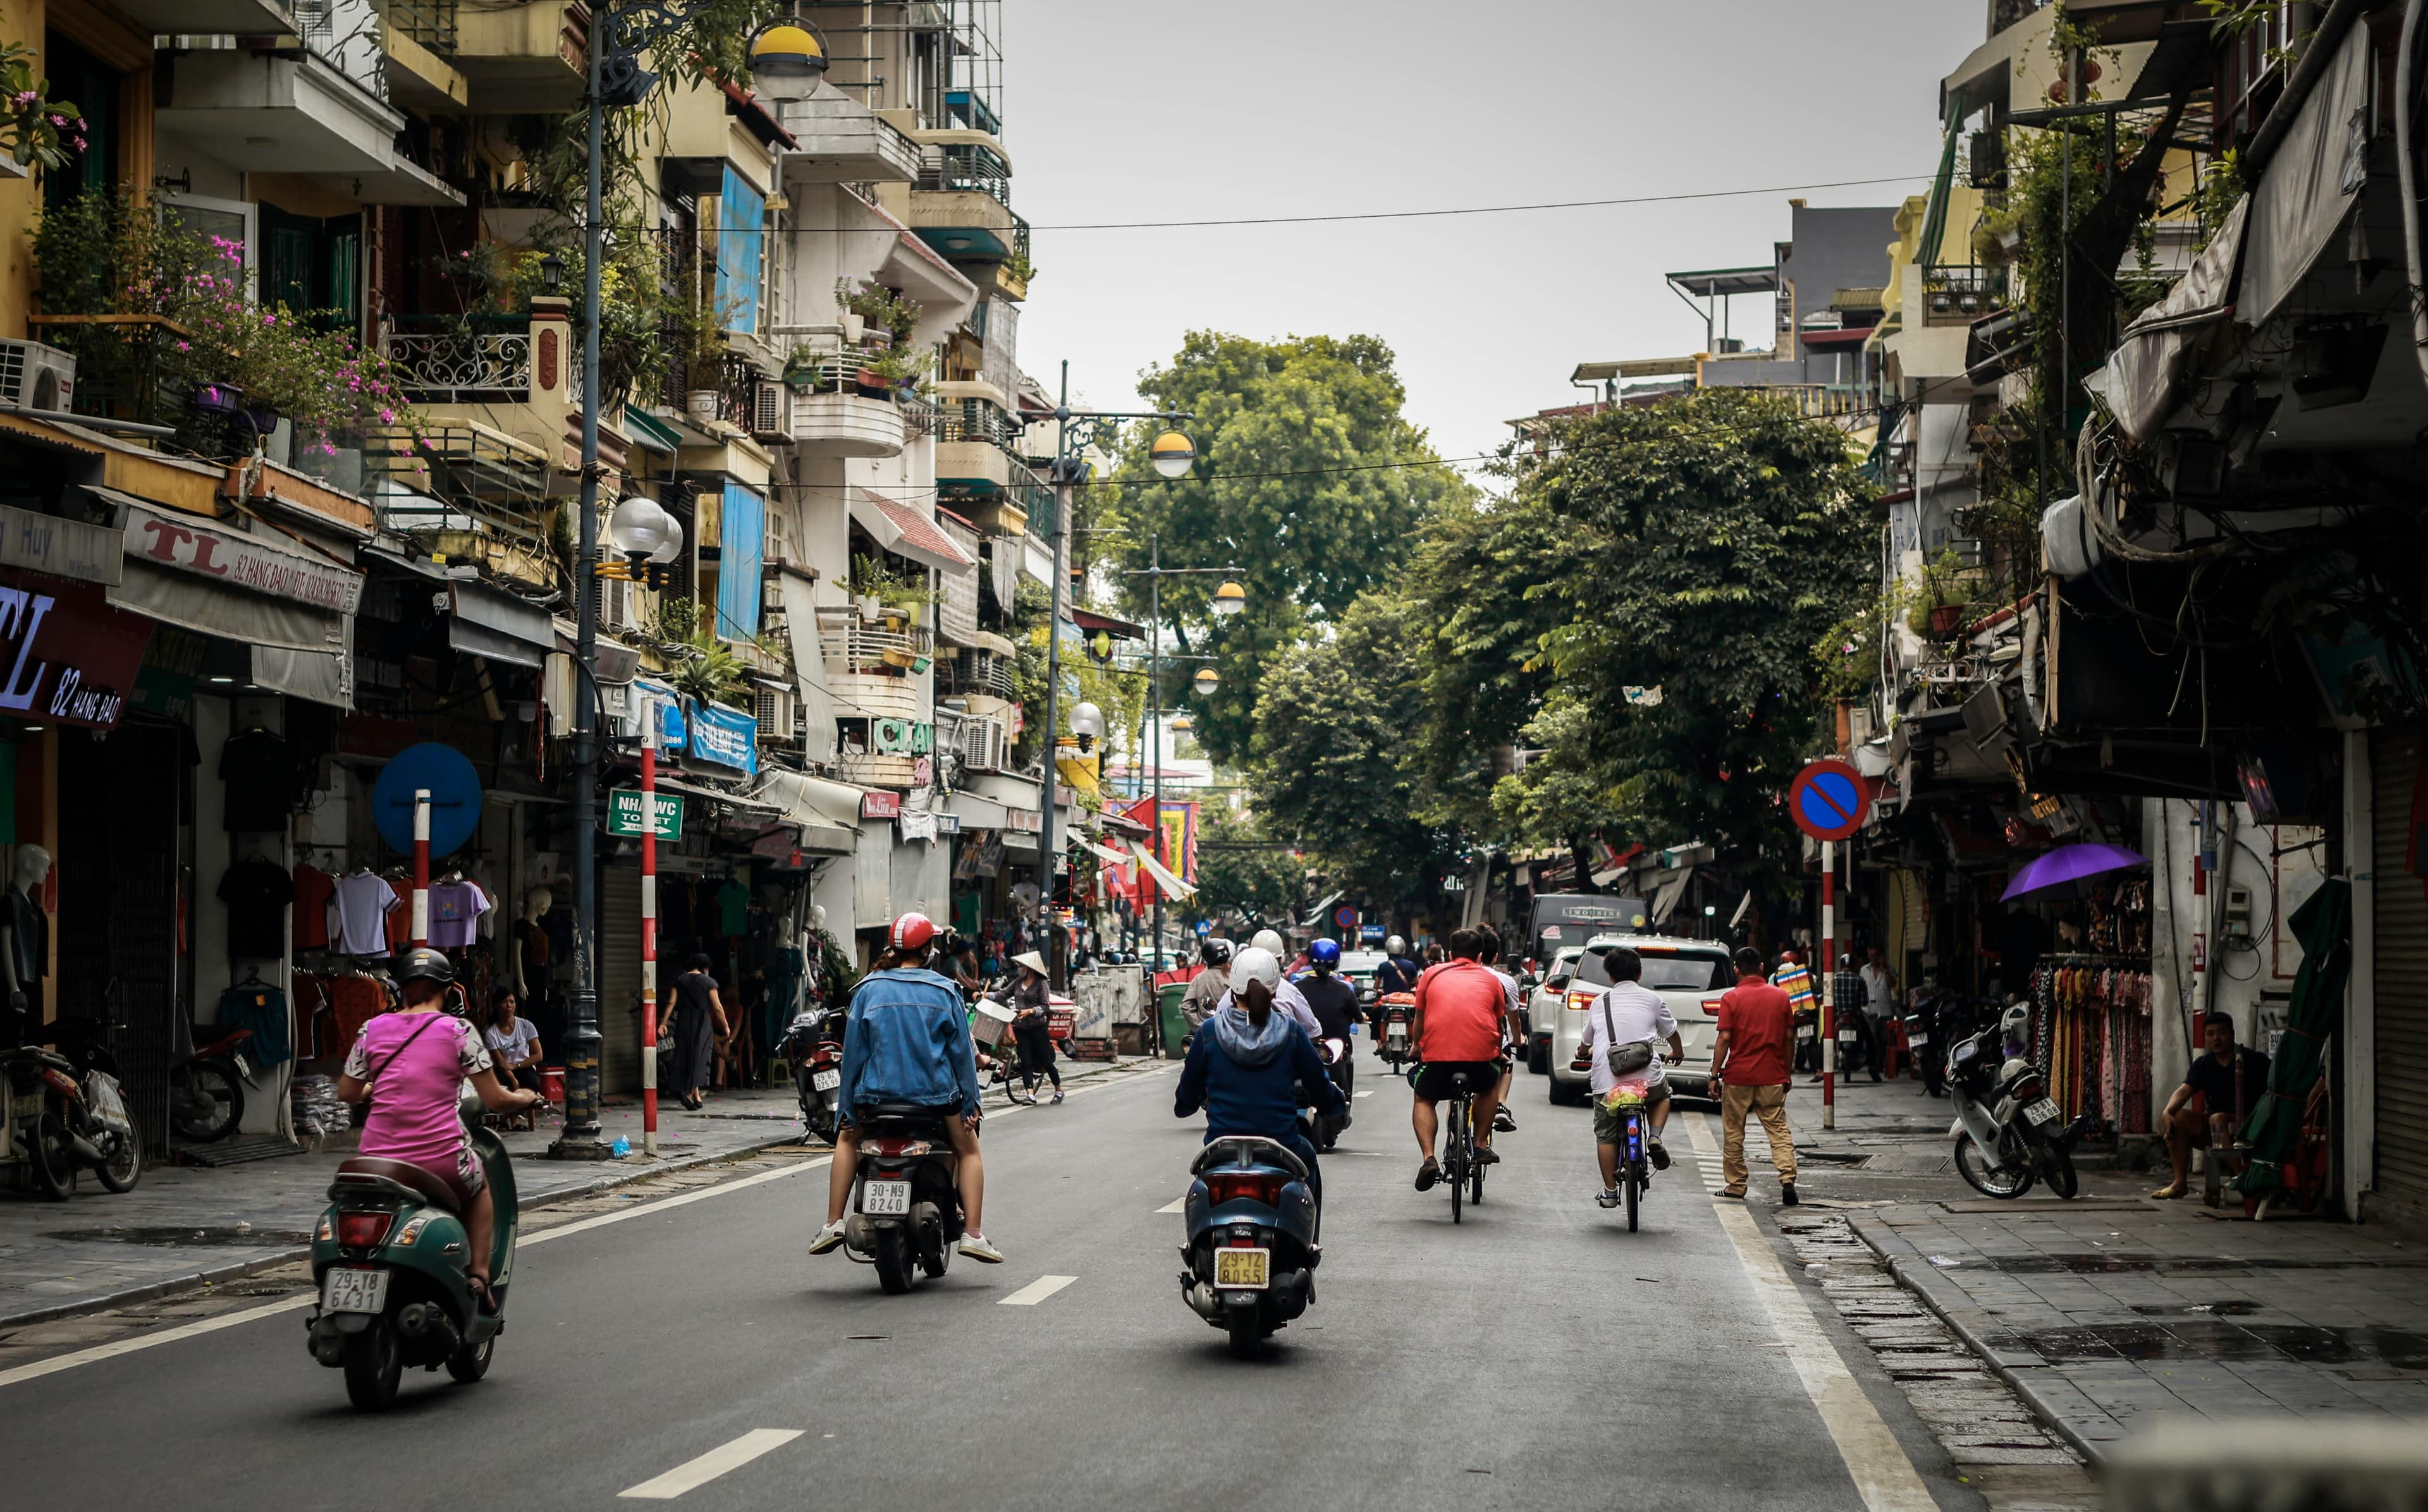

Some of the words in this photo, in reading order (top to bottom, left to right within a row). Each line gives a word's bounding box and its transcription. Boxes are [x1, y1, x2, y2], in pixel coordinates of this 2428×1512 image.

[20, 515, 52, 567] Huy
[144, 520, 228, 575] TL
[234, 554, 248, 580] 82
[50, 668, 81, 716] 82
[622, 813, 671, 826] TOET
[2028, 1099, 2051, 1115] 29-B1
[871, 1184, 905, 1197] 30-M9
[869, 1198, 903, 1212] 8240
[334, 1272, 379, 1291] 29-Y8
[1223, 1269, 1261, 1284] 8055
